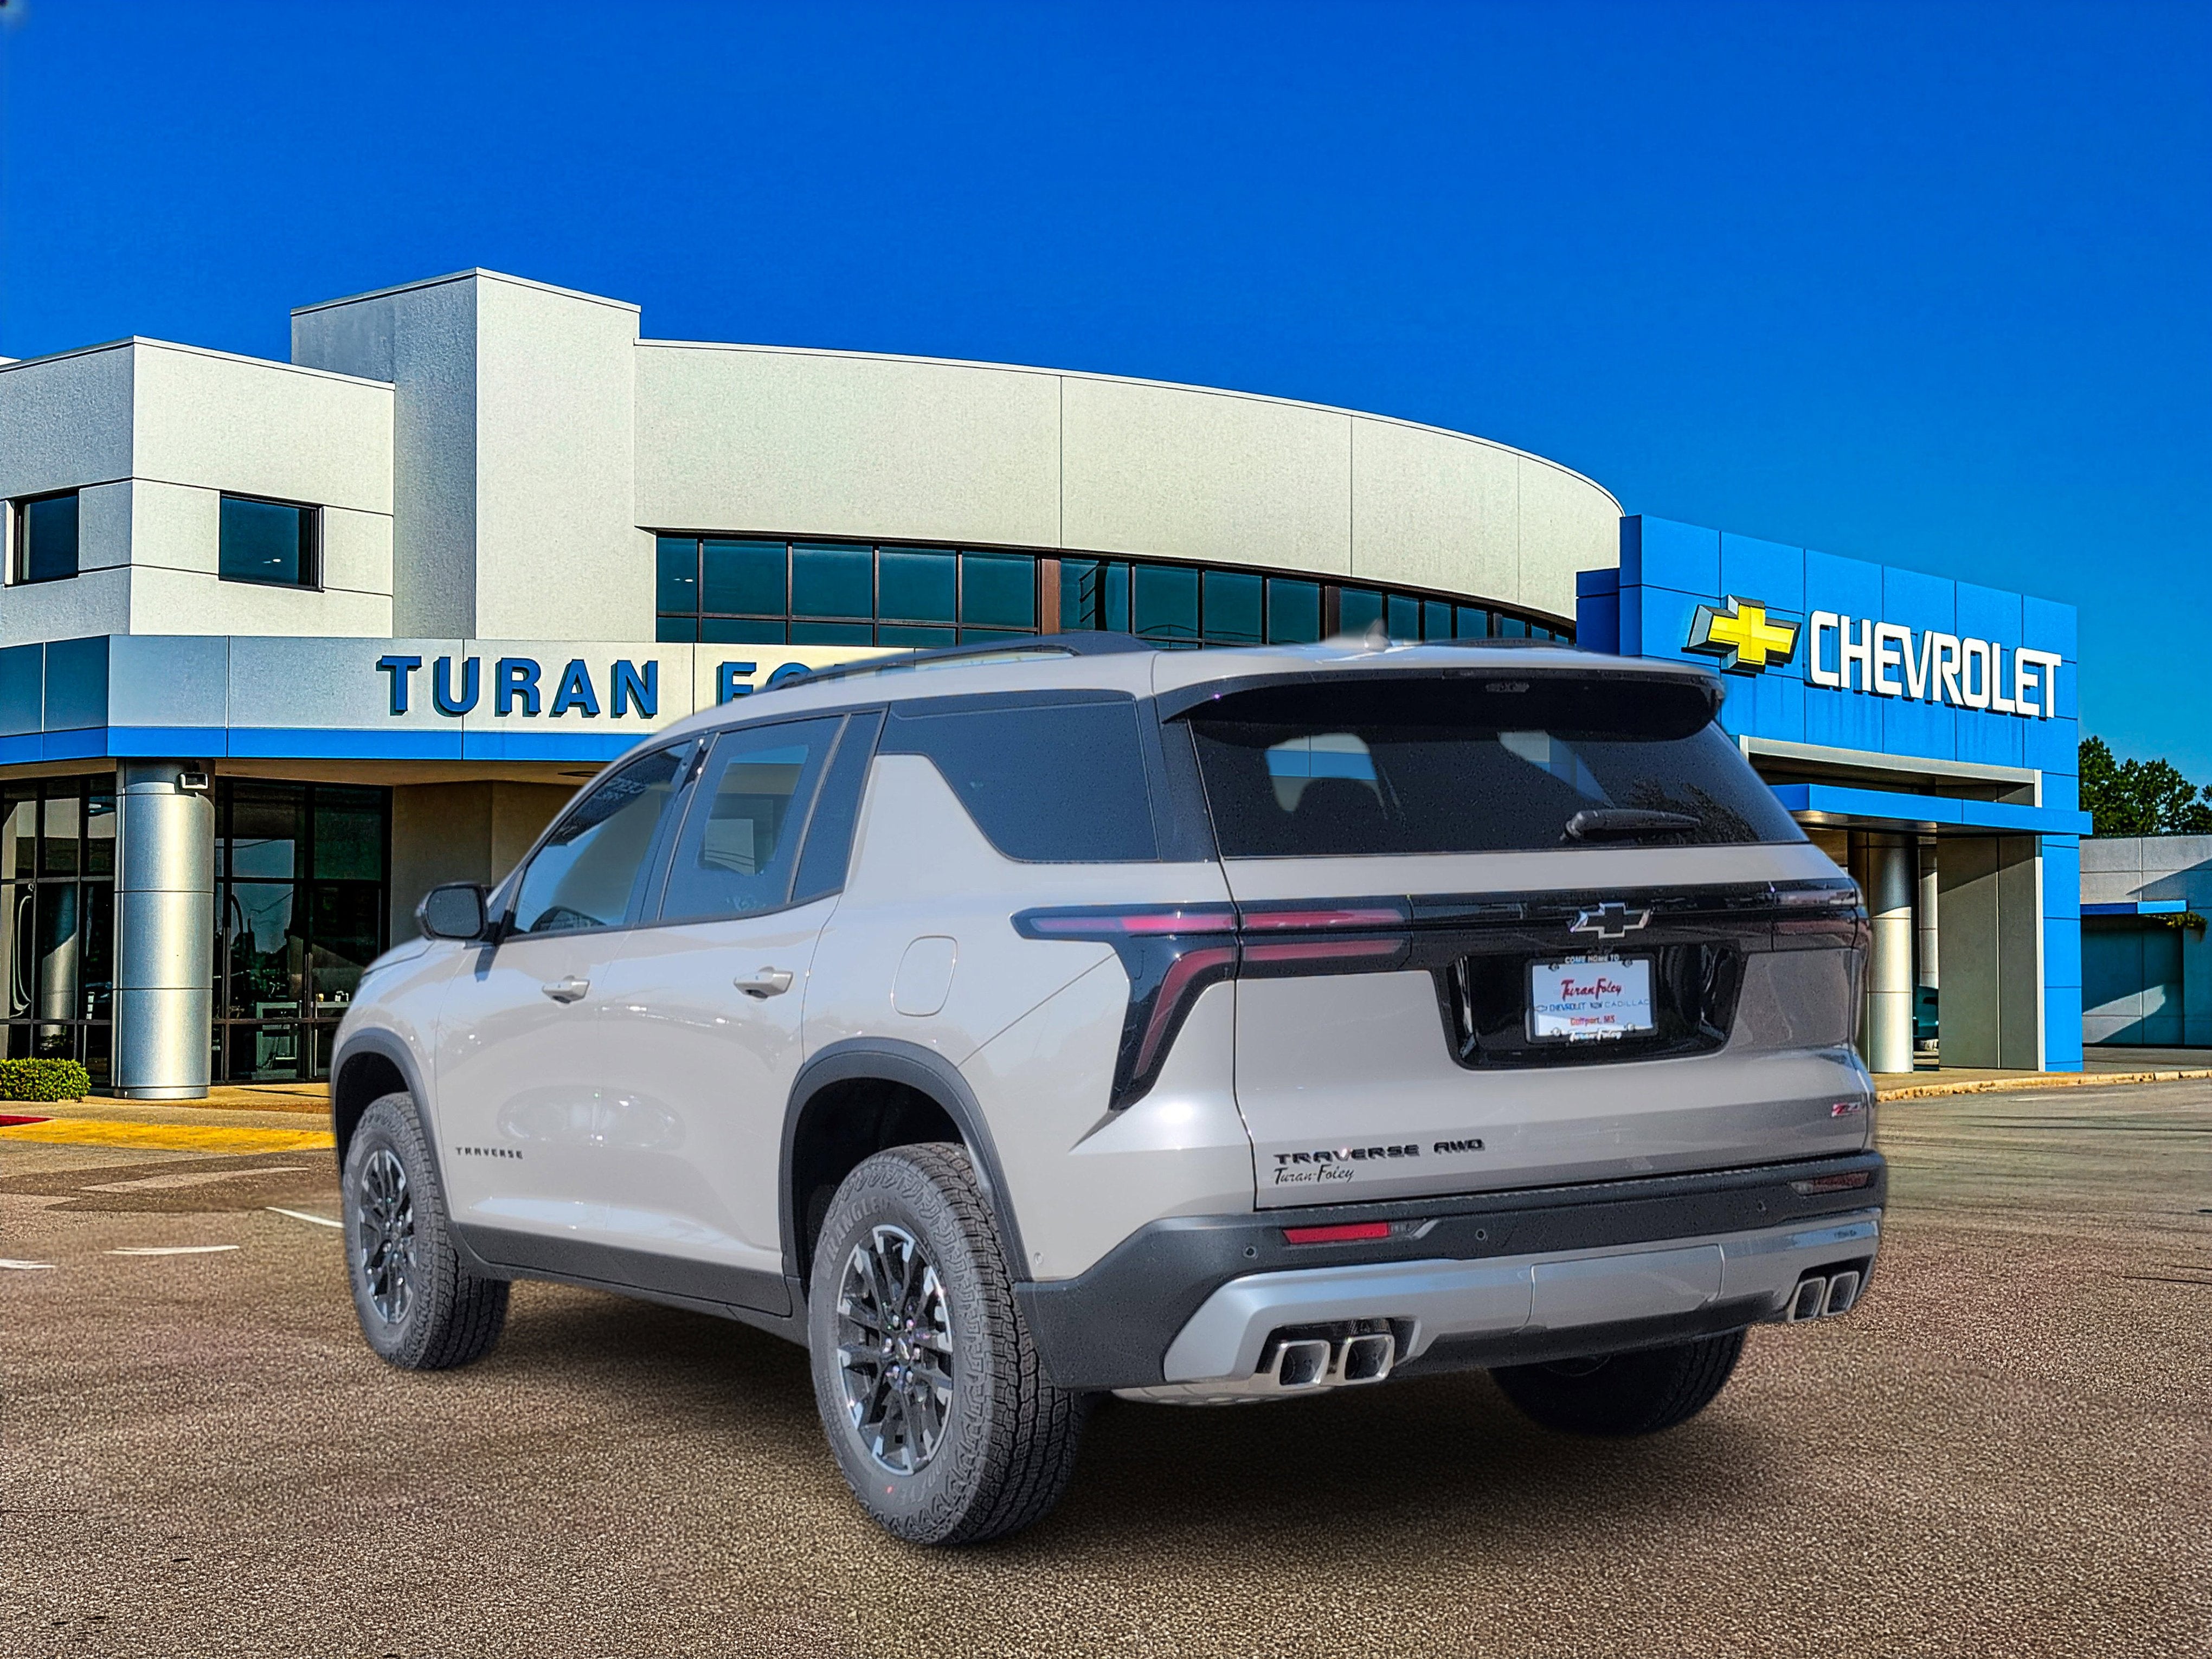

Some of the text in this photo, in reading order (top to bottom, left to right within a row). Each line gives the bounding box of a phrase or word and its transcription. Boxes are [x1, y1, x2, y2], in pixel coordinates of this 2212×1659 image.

[1810, 609, 2062, 719] CHEVROLET
[376, 656, 658, 719] TURAN
[455, 1147, 523, 1160] TRAVERSE
[1273, 1139, 1486, 1165] TRAVERSE AWD
